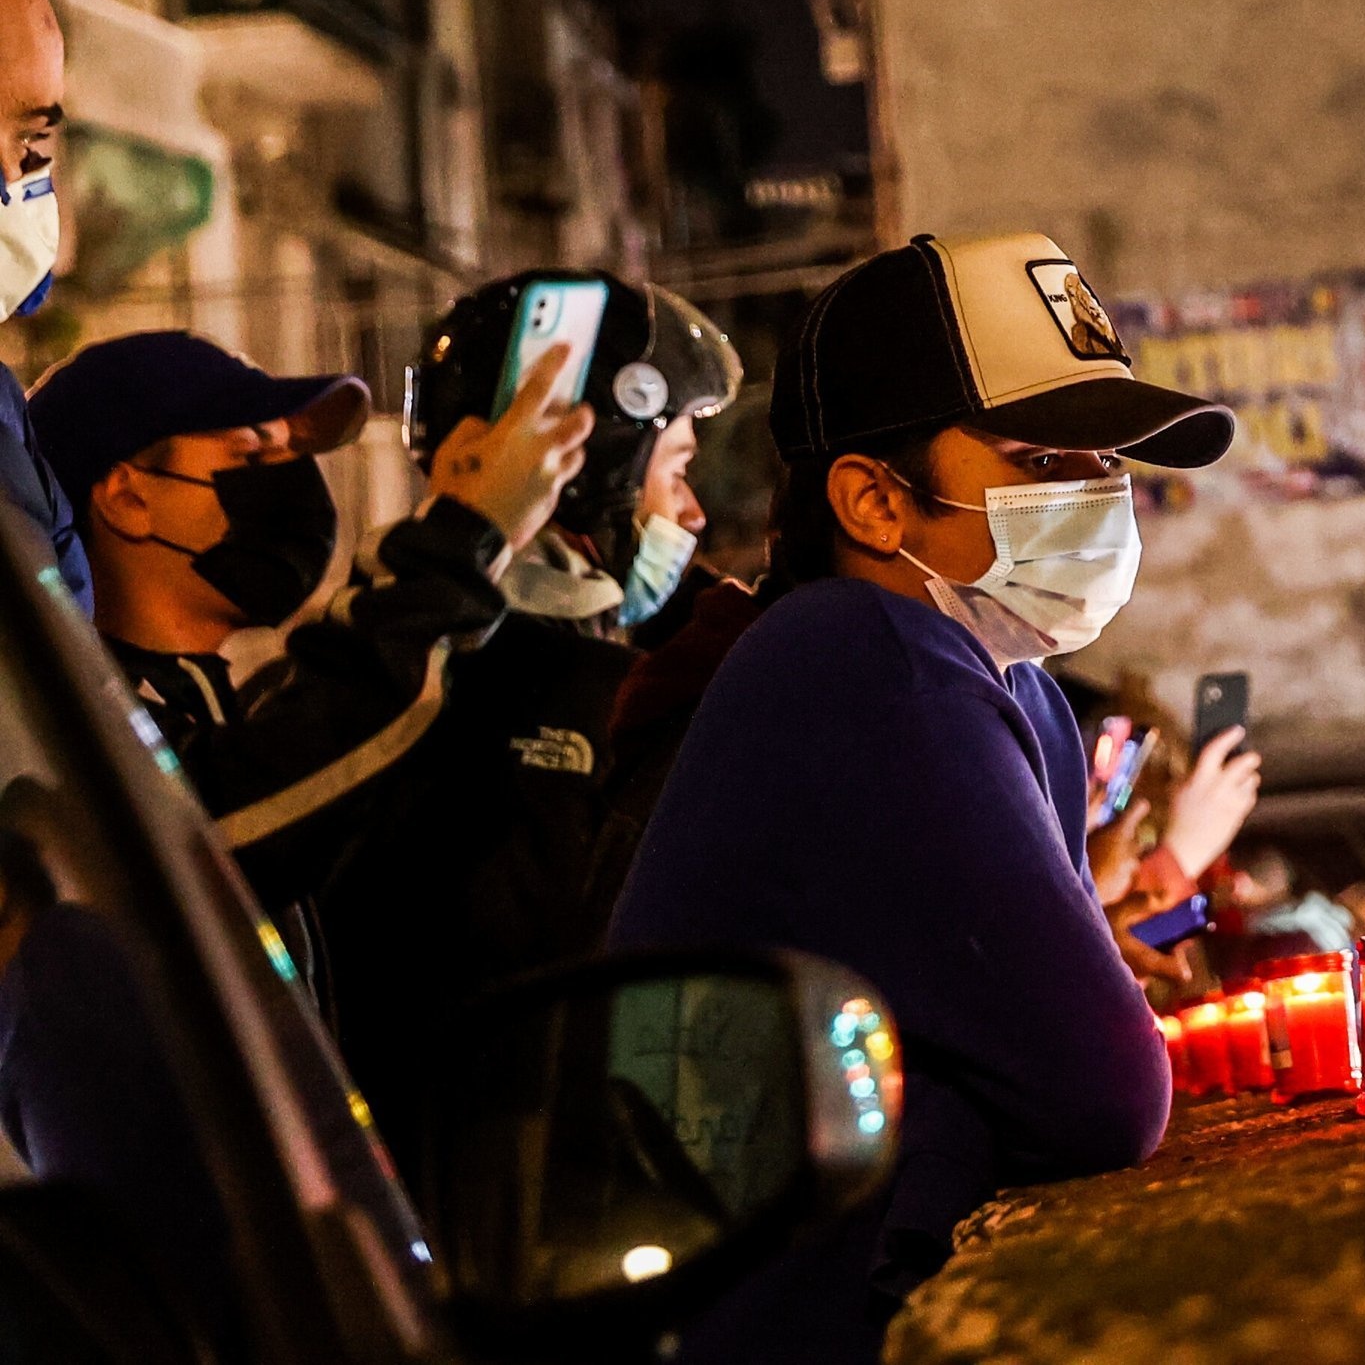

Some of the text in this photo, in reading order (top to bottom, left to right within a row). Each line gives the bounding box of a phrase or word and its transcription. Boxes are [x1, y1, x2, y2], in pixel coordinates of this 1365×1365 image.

[1047, 293, 1068, 303] KING
[539, 725, 565, 741] THE
[510, 737, 561, 755] NORTH
[521, 751, 560, 770] FACE
